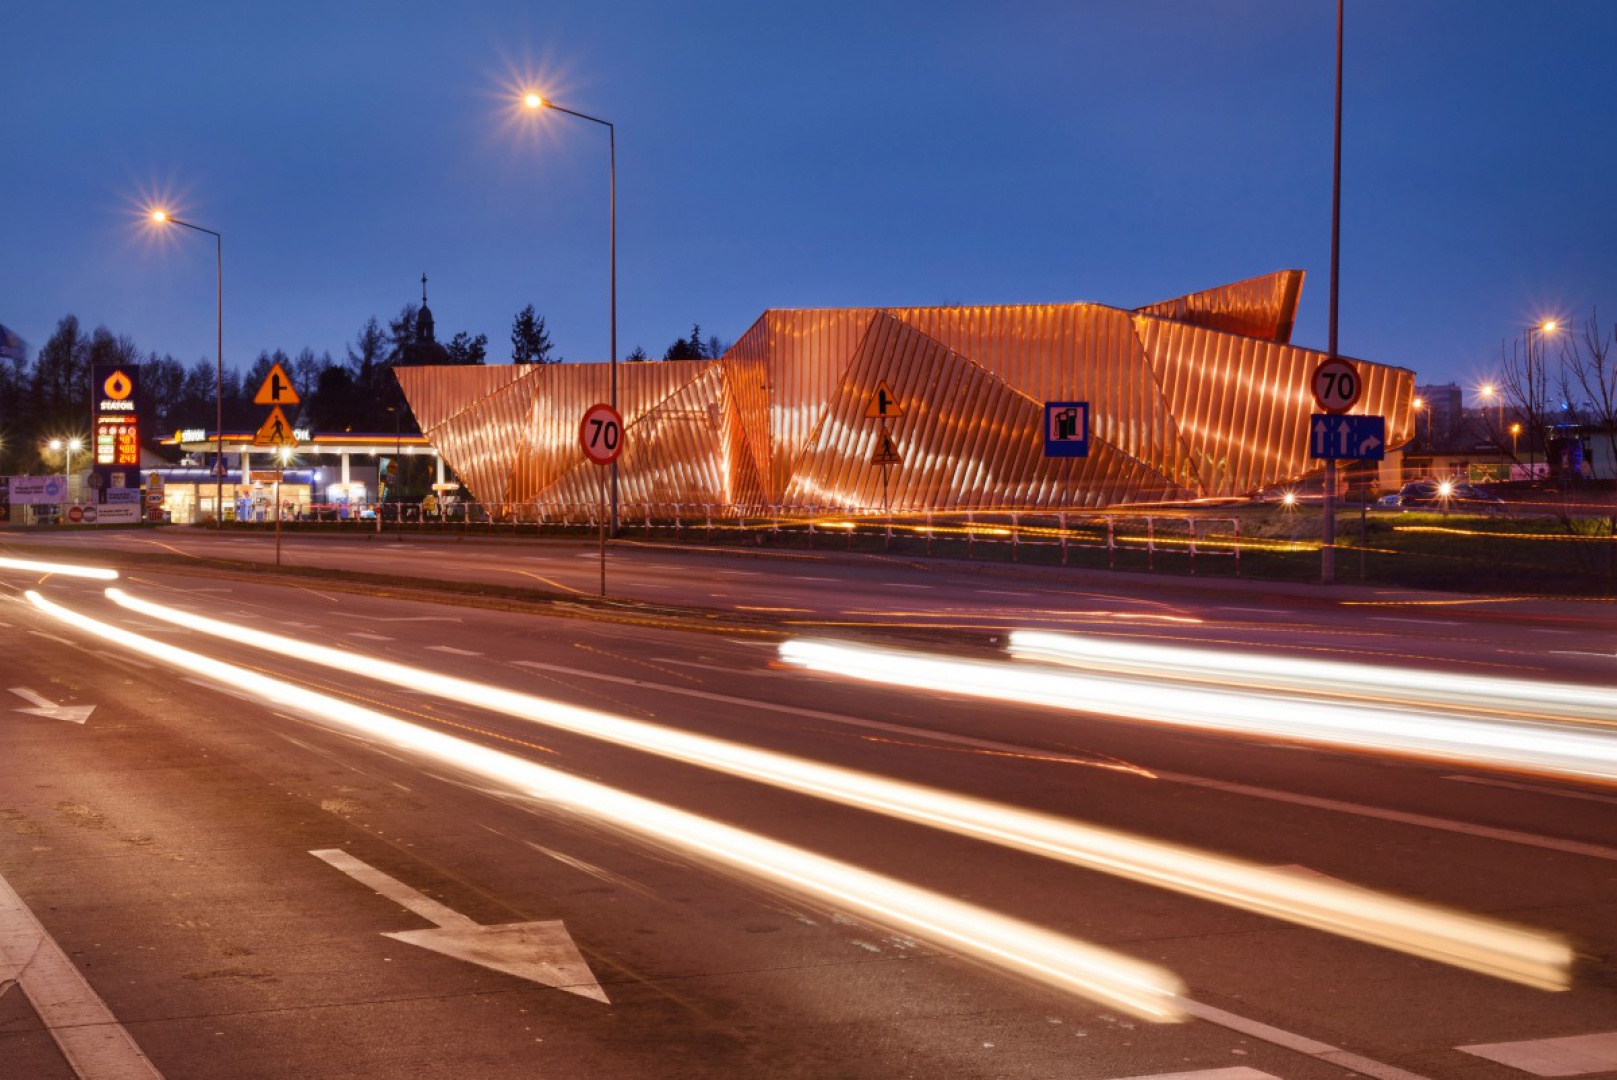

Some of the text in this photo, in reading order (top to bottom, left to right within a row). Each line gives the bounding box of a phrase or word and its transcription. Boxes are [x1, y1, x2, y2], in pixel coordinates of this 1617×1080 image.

[1321, 372, 1355, 401] 70
[100, 401, 134, 411] STATOIL
[590, 418, 618, 450] 70
